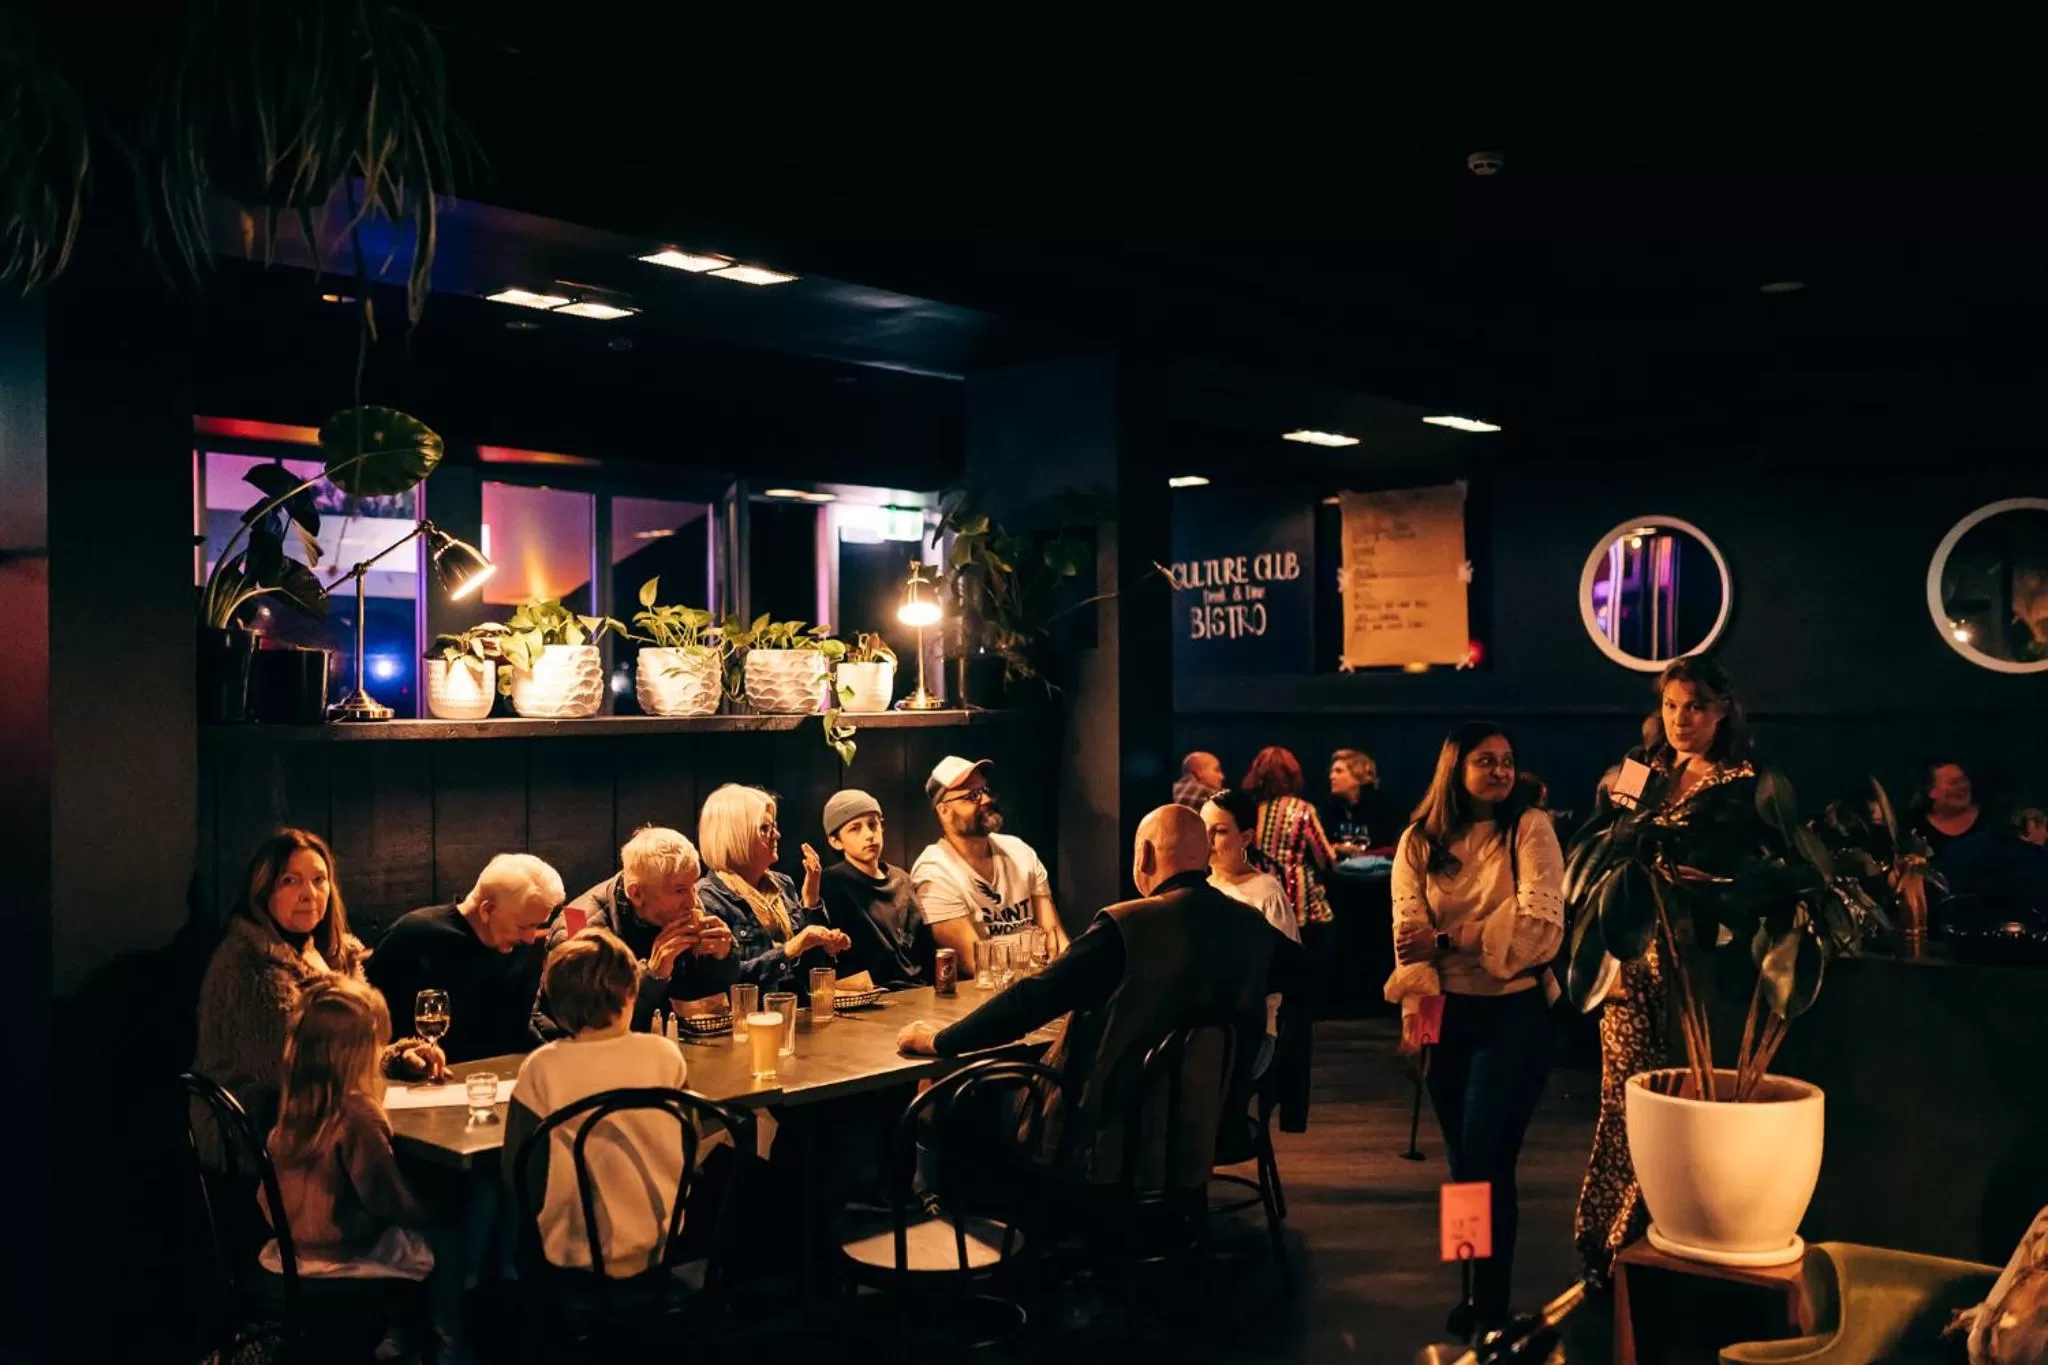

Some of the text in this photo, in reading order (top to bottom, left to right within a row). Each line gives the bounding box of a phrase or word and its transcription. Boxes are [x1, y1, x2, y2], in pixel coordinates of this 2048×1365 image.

[1171, 551, 1300, 589] CULTURE CLUB
[1190, 603, 1267, 639] BISTRO
